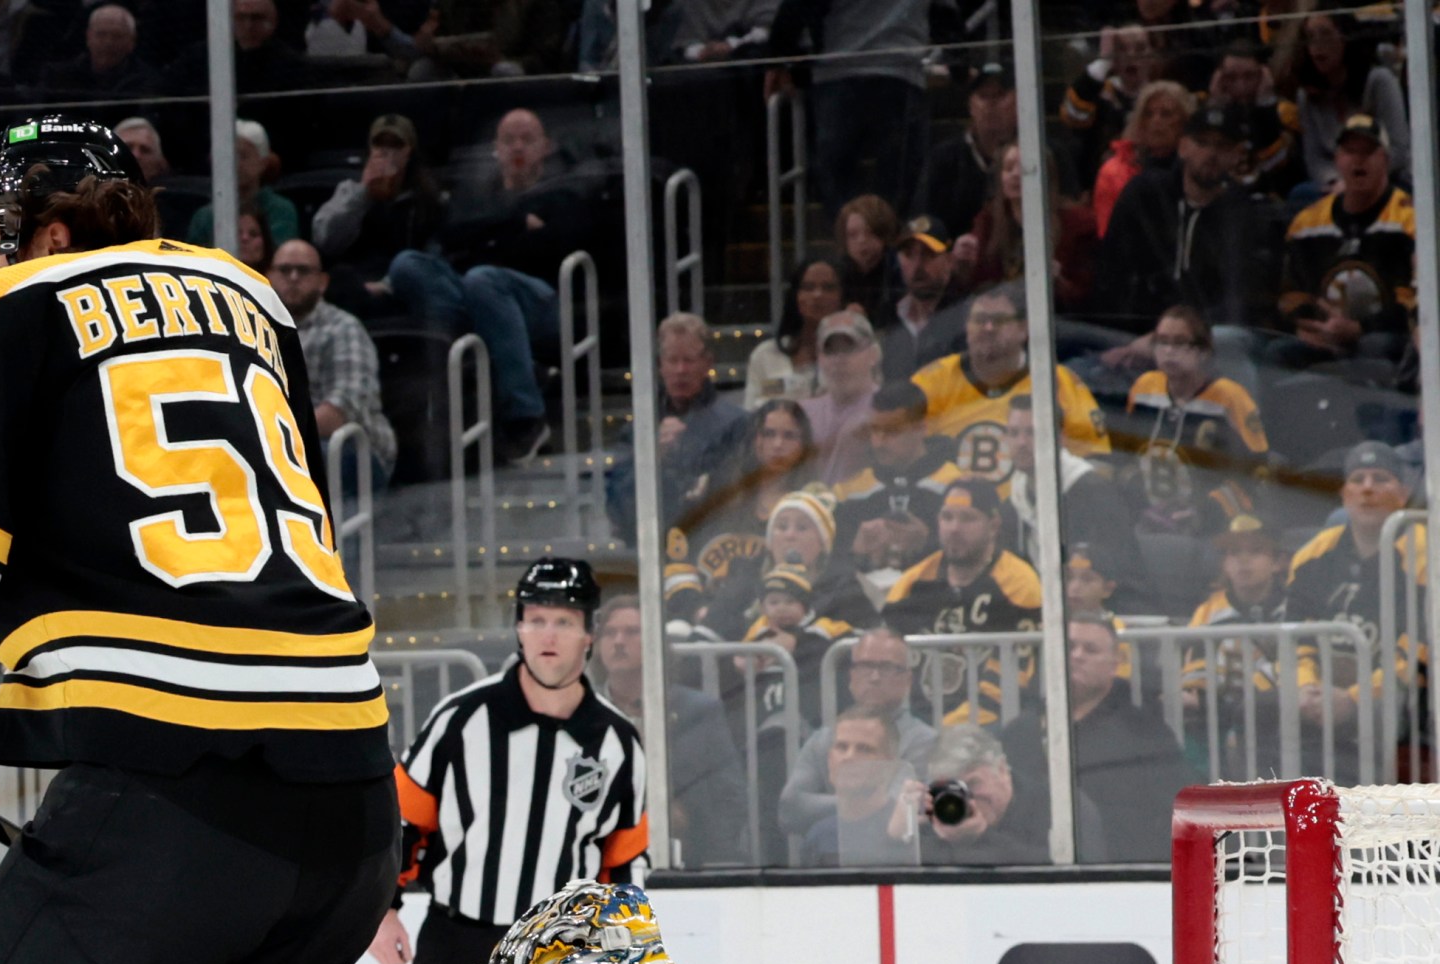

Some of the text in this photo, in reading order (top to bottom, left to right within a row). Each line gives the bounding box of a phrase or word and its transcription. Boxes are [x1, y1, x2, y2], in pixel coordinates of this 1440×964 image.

[40, 123, 85, 134] Bank
[99, 349, 356, 601] 59
[970, 593, 992, 625] C
